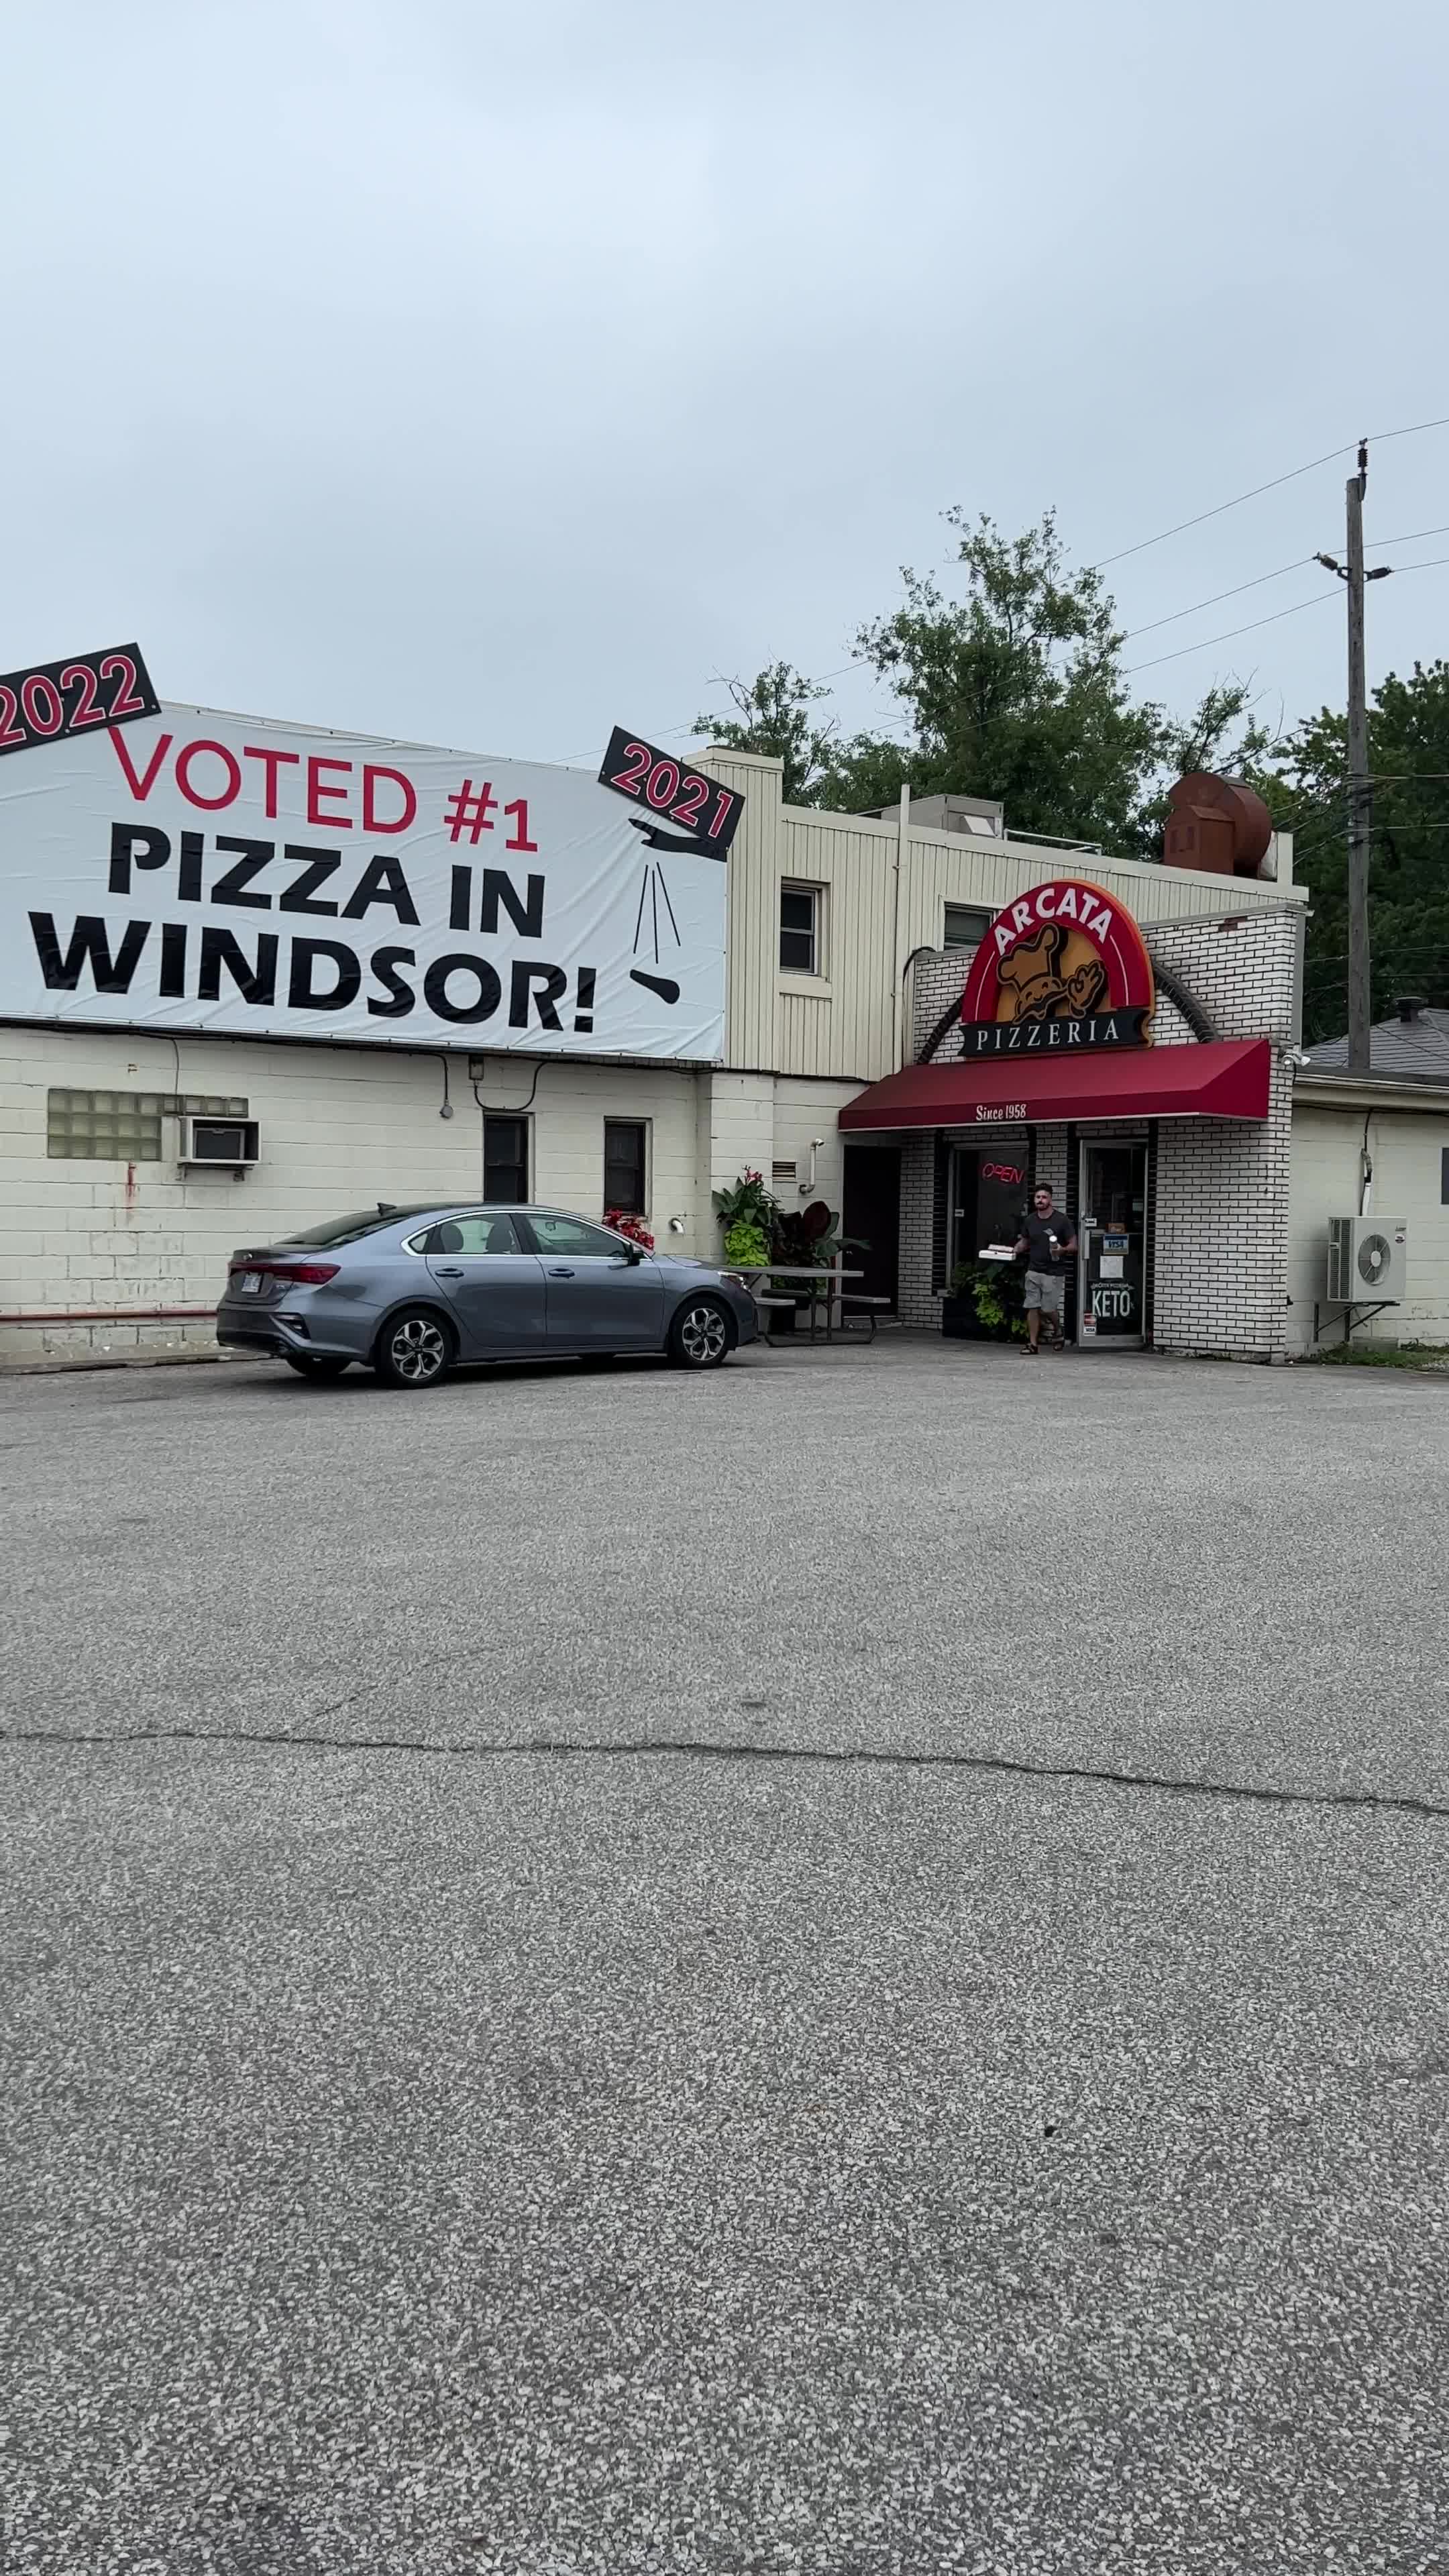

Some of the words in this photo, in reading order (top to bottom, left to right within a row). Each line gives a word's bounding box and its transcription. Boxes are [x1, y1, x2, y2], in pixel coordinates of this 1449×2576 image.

[0, 654, 145, 746] 2022
[107, 727, 417, 834] VOTED
[444, 780, 538, 851] #1
[611, 743, 735, 838] 2021
[109, 822, 421, 926] PIZZA
[449, 865, 545, 938] IN
[994, 888, 1114, 956] ARCATA
[28, 911, 596, 1033] WINDSOR!
[976, 1018, 1120, 1051] PIZZERIA
[976, 1105, 1004, 1121] Since
[1005, 1104, 1027, 1119] 1958
[982, 1163, 1025, 1184] OPEN
[1092, 1290, 1130, 1318] KETO
